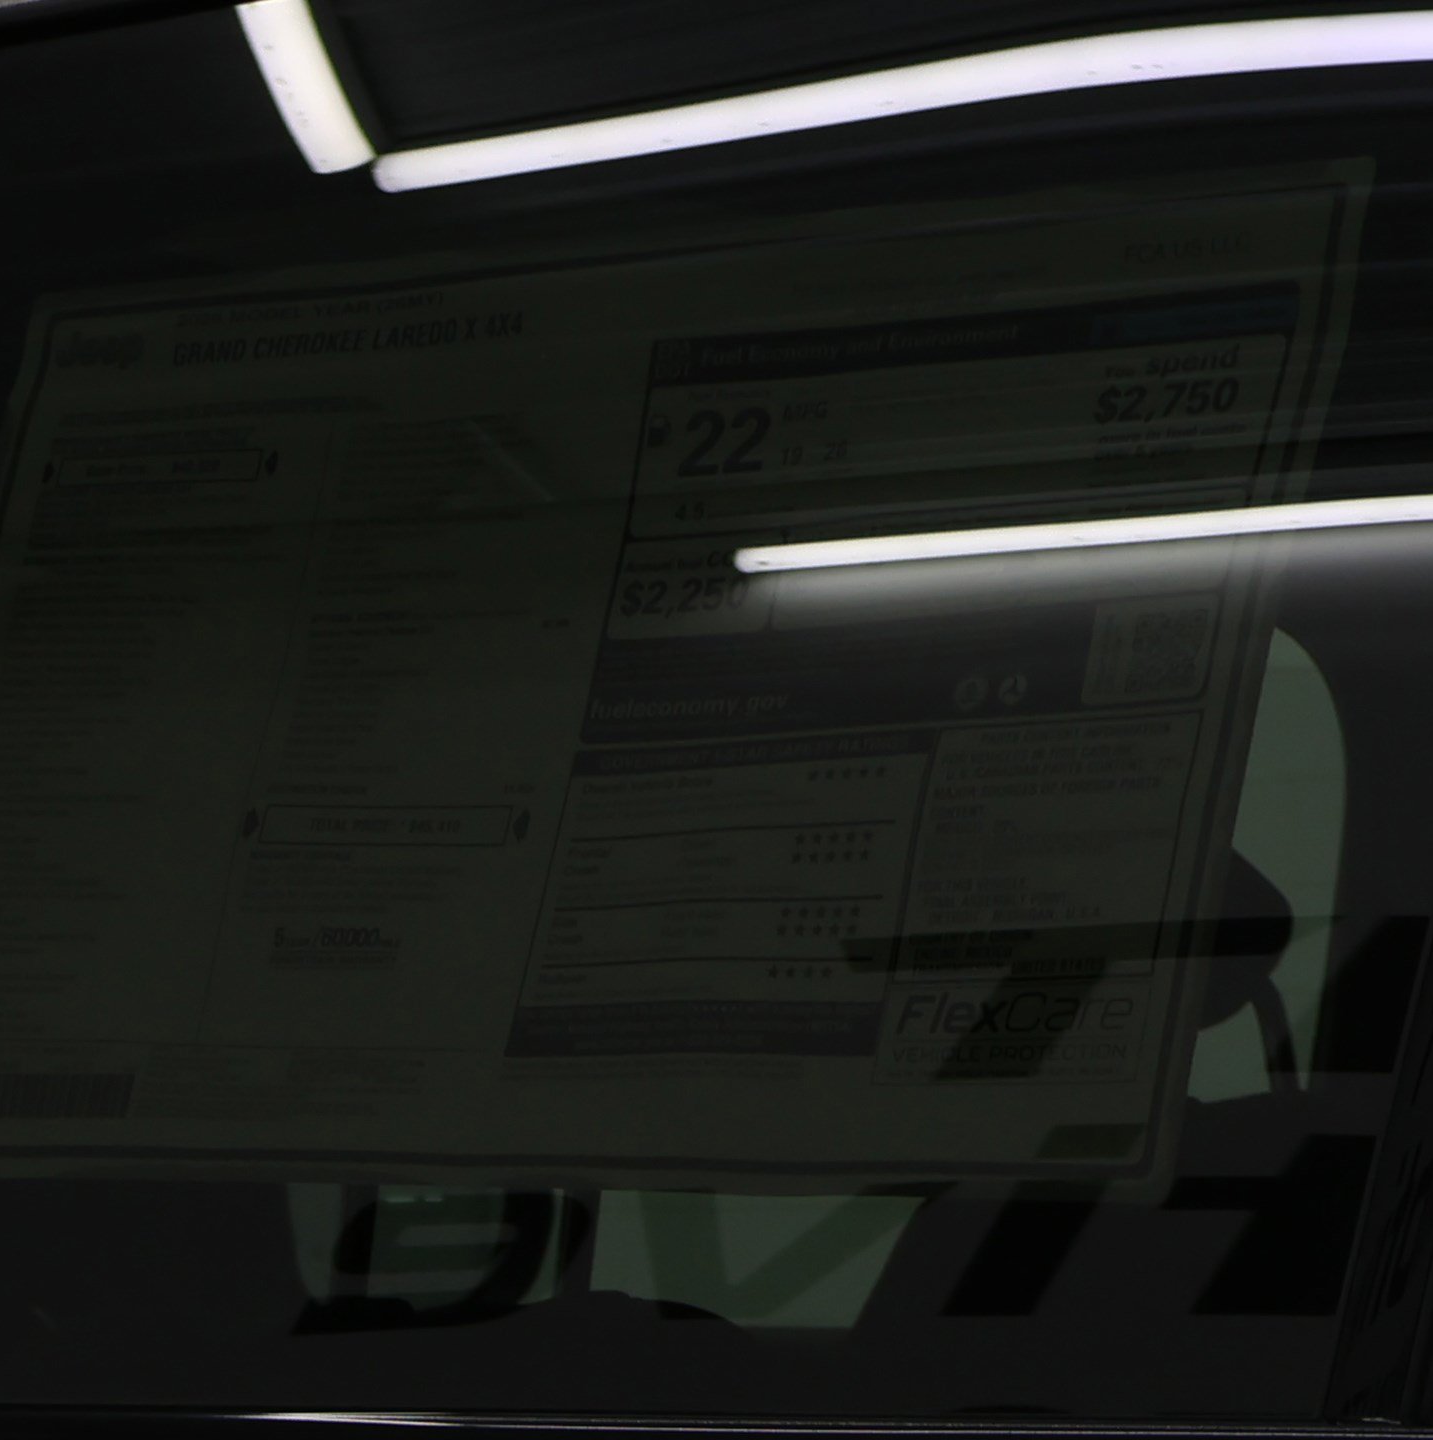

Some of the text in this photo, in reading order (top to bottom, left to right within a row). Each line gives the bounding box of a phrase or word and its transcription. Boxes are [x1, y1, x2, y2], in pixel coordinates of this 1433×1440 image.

[172, 310, 524, 368] GRAND CHEROKEE LAREDO X 4X4
[700, 324, 1021, 368] Fuel Economy and Environment
[1144, 341, 1241, 378] spend
[1092, 376, 1240, 425] $2,750
[677, 406, 772, 478] 22
[620, 577, 751, 618] $2,250
[589, 692, 792, 721] fueleconomy.gov
[308, 817, 347, 833] TOTAL
[895, 991, 1134, 1035] FlexCare
[893, 1042, 1128, 1063] VEHICLE PROTECTION
